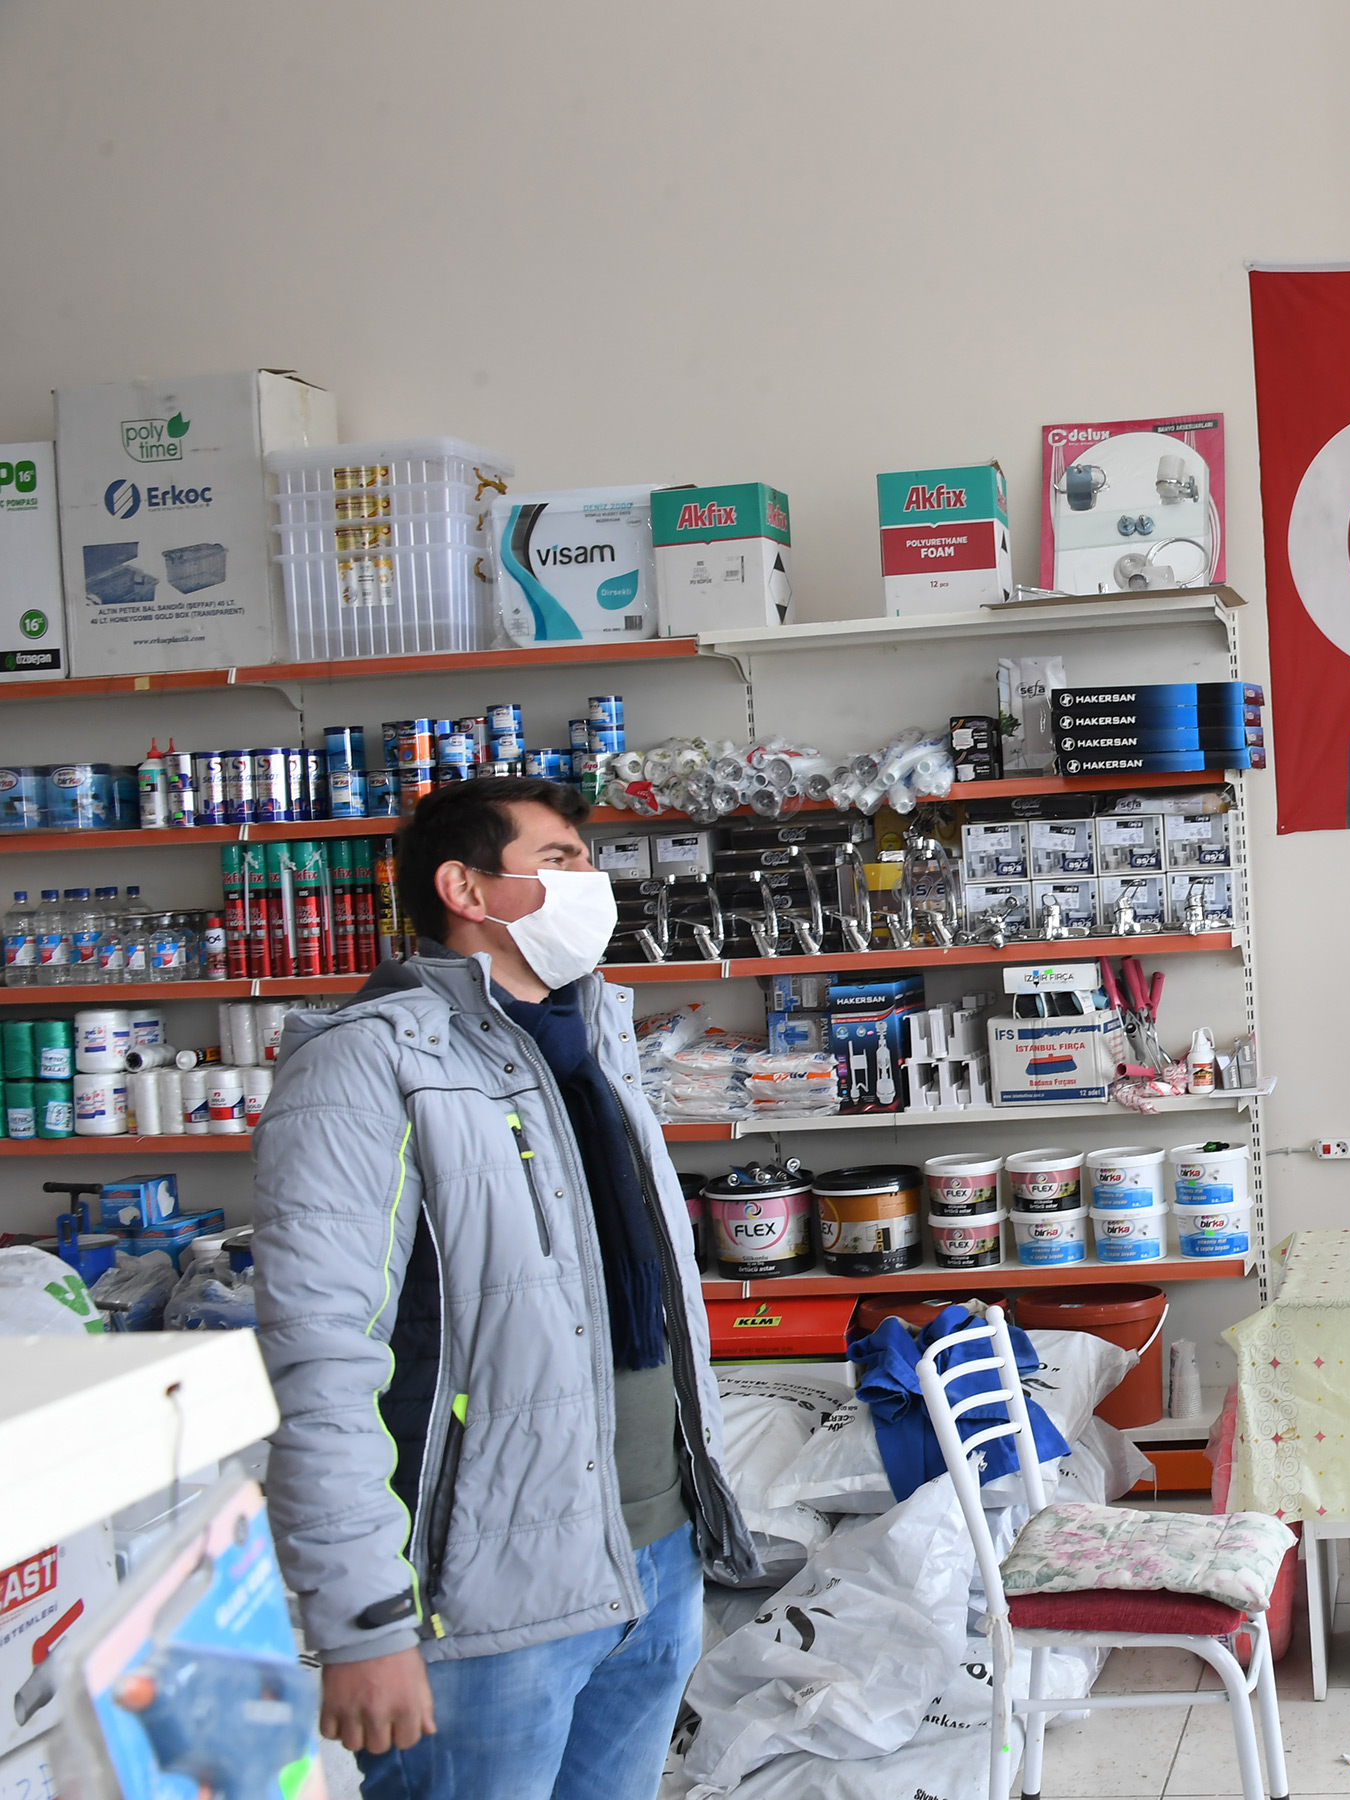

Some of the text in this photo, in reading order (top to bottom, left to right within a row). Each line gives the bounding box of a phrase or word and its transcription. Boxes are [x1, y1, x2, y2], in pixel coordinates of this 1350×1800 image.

[125, 422, 164, 447] poly
[139, 441, 178, 459] time
[18, 471, 31, 483] 16
[903, 484, 966, 512] Akfix
[676, 501, 737, 531] Akfix
[906, 536, 968, 547] POLYURETHANE
[536, 544, 615, 566] visam
[920, 547, 955, 558] FOAM
[601, 588, 631, 596] Dirsekli
[99, 607, 118, 616] ALTIN
[119, 606, 141, 614] PETEK
[143, 605, 156, 613] BAL
[110, 613, 153, 624] HONEYCOMB
[155, 612, 174, 621] GOLD
[175, 610, 190, 619] BOX
[191, 607, 245, 619] (TRANSPARENT)
[24, 618, 39, 633] 16
[1020, 679, 1046, 698] sefa
[1075, 693, 1137, 704] HAKERSAN
[1075, 716, 1137, 726] HAKERSAN
[1077, 738, 1138, 748] HAKERSAN
[584, 763, 598, 771] dyo
[1083, 760, 1144, 770] HAKERSAN
[1120, 799, 1142, 811] sefa
[1050, 973, 1074, 981] FIRÇA
[837, 996, 885, 1005] HAKERSAN
[820, 1017, 829, 1050] PALEX
[995, 1028, 1015, 1041] İFS
[1015, 1042, 1086, 1052] İSTANBUL FIRÇA
[1099, 1173, 1121, 1182] birka
[1180, 1169, 1200, 1177] birka
[1032, 1184, 1053, 1192] FLEX
[946, 1190, 968, 1198] FLEX
[1200, 1219, 1225, 1228] birka
[734, 1222, 776, 1238] FLEX
[1034, 1228, 1058, 1237] birka
[1107, 1225, 1130, 1234] birka
[948, 1241, 970, 1249] FLEX
[759, 1265, 776, 1273] astar
[738, 1318, 774, 1326] KLM
[828, 1422, 843, 1432] TÜV
[922, 1714, 971, 1729] ARKASI
